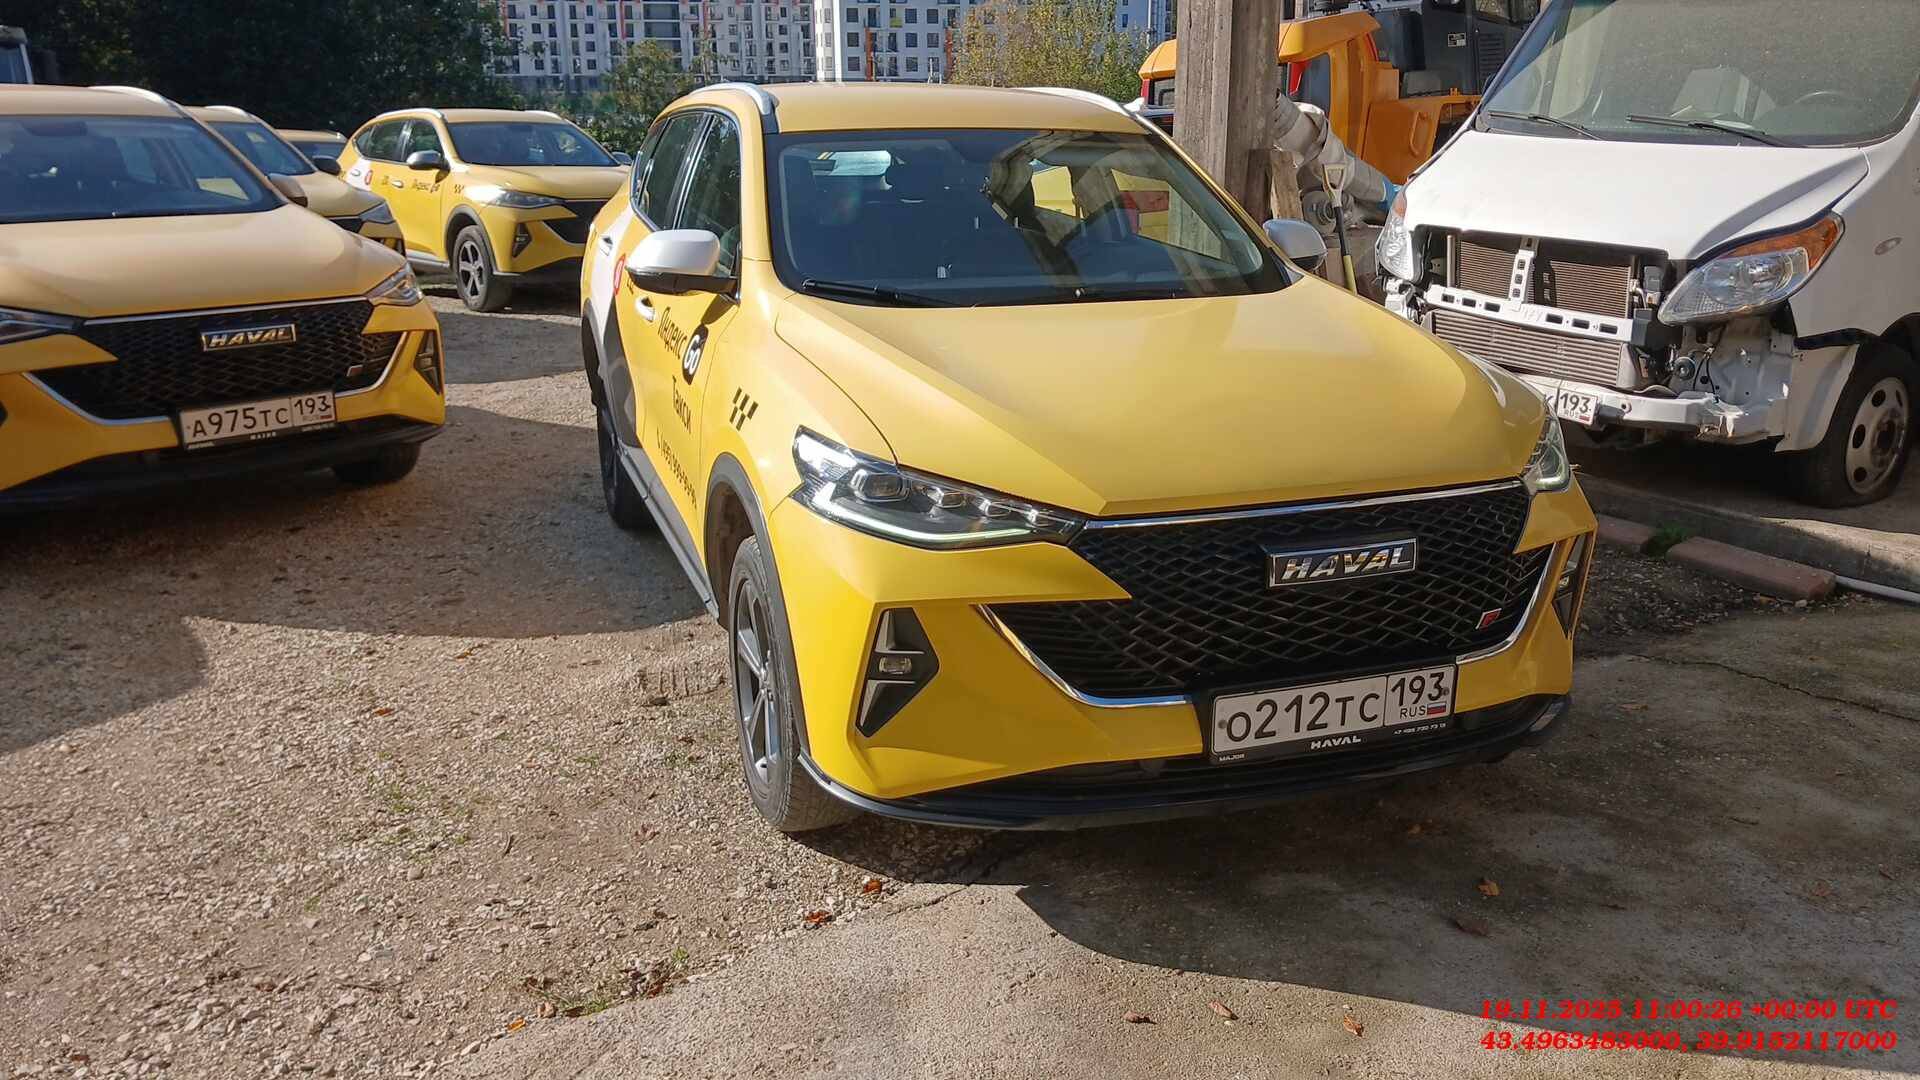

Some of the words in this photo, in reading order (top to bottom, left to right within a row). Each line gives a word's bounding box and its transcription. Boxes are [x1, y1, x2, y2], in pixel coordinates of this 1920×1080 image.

[209, 327, 291, 348] HAVAL
[658, 306, 687, 360] Яндекс
[294, 395, 330, 415] 193
[672, 374, 691, 435] Такси
[1560, 392, 1591, 414] 193
[1281, 546, 1411, 580] HAVAL
[1391, 671, 1445, 706] 193
[1400, 705, 1426, 719] RUS
[1311, 734, 1362, 750] HAVAL
[1219, 753, 1245, 762] MAJOR
